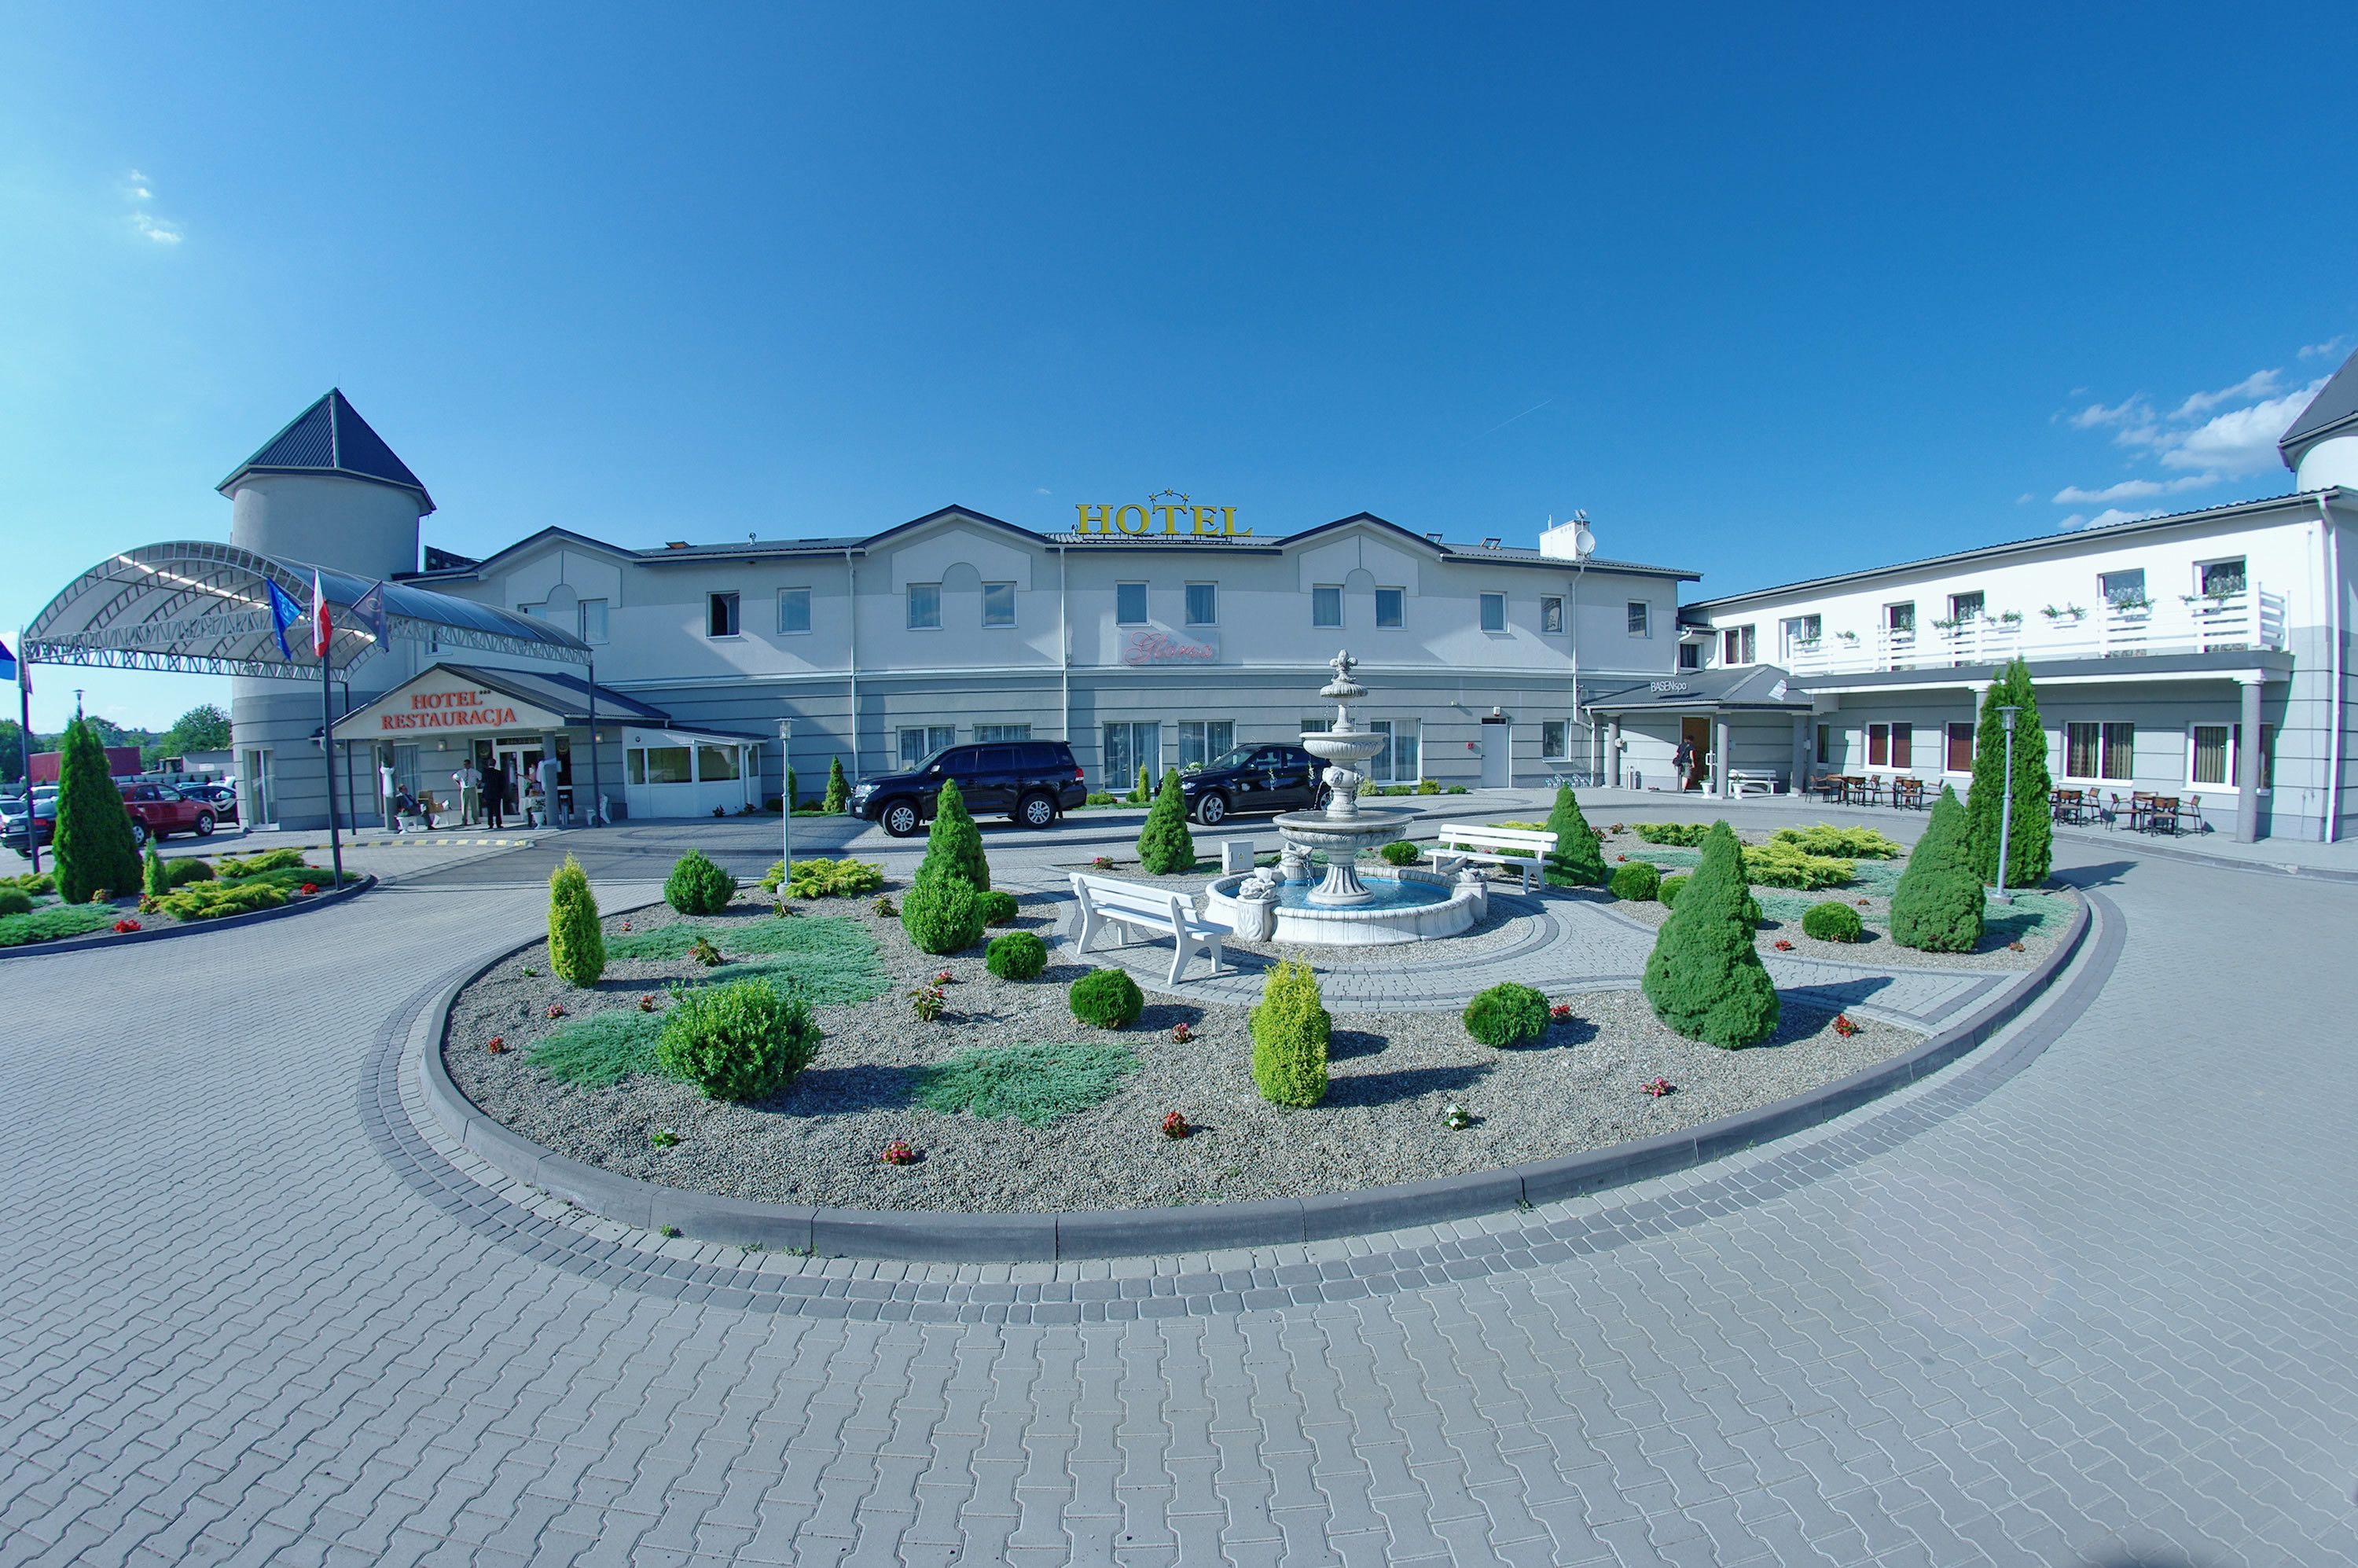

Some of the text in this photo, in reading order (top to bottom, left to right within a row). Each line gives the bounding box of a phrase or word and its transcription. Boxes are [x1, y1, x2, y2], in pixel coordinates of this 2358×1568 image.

[1075, 504, 1253, 537] HOTEL
[411, 691, 483, 710] HOTEL
[381, 708, 516, 730] RESTAURACJA
